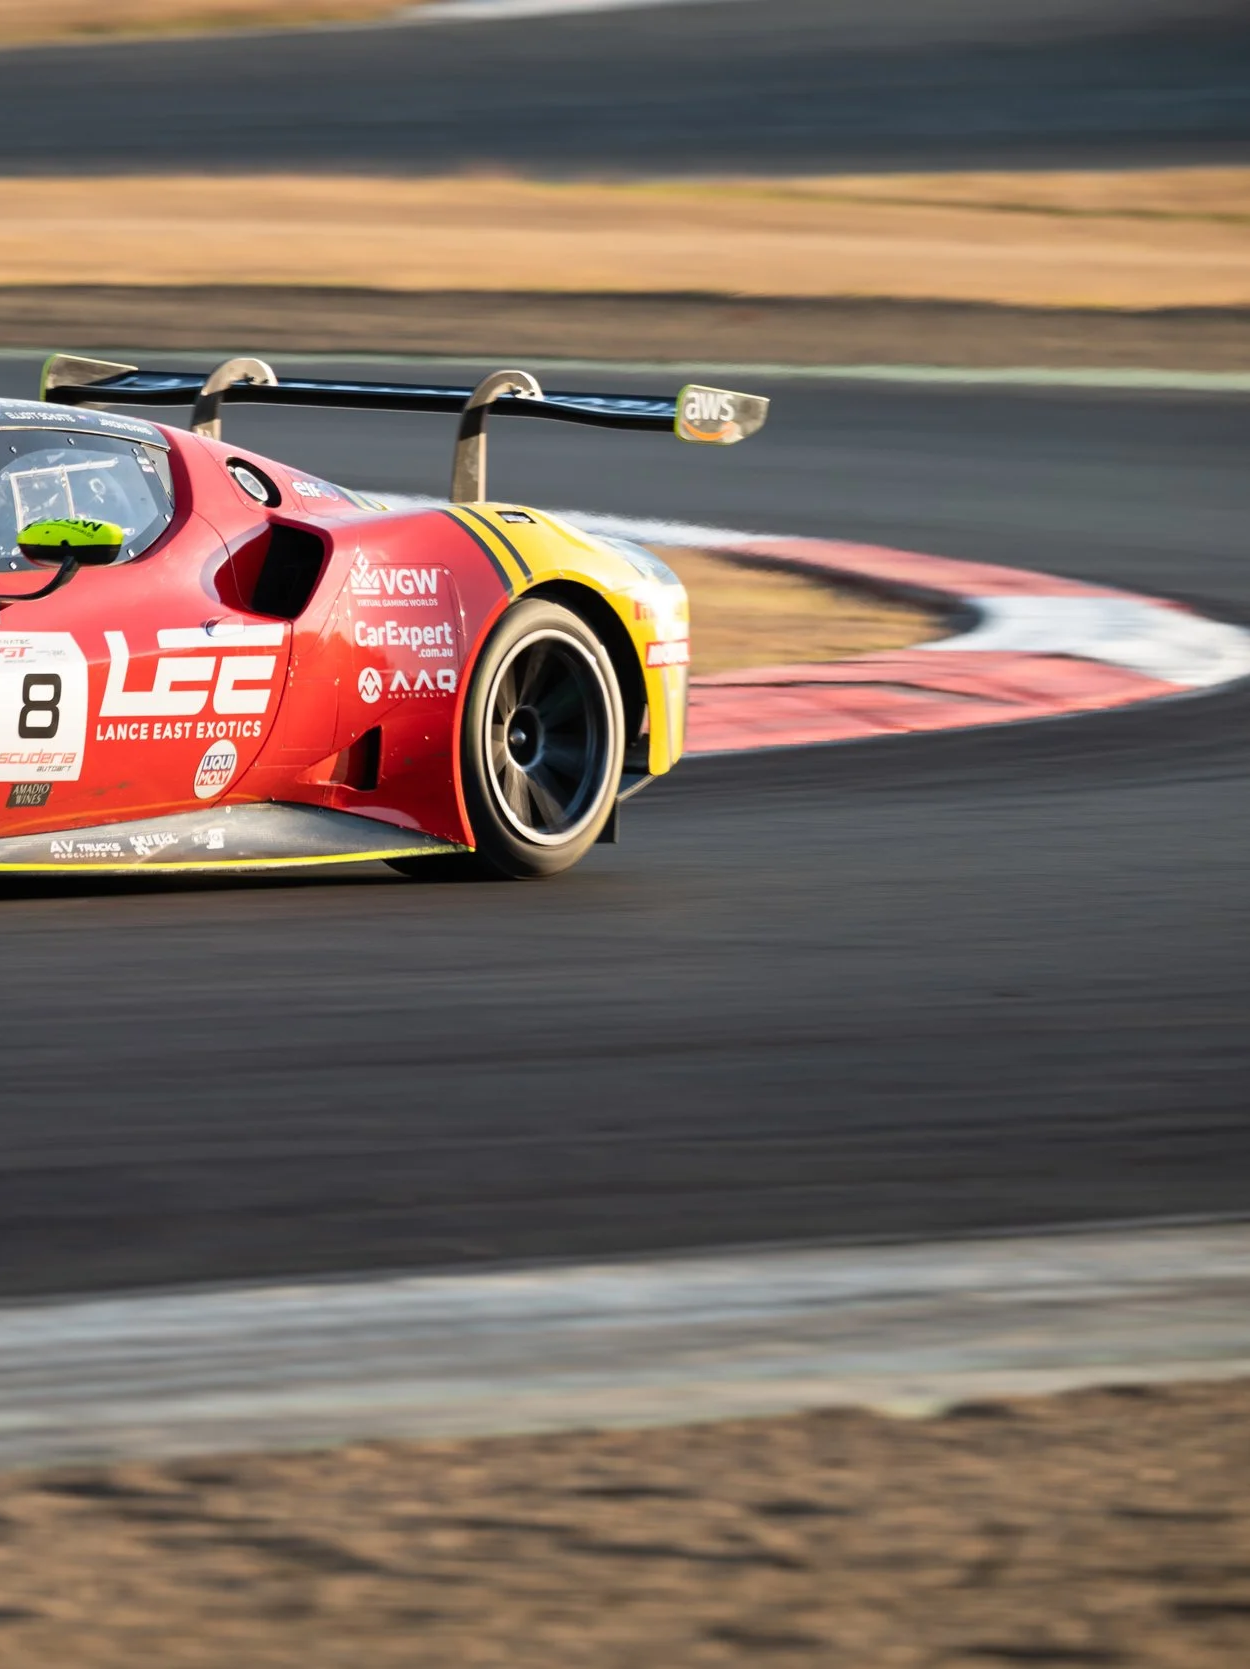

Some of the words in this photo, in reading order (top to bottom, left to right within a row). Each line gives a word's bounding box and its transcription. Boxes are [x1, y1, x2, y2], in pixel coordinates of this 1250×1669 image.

[685, 391, 735, 421] aws
[291, 481, 322, 498] elf
[379, 568, 437, 595] VGW
[357, 599, 381, 607] VIRTUAL
[382, 599, 409, 607] GAMING
[409, 599, 438, 607] WORLDS
[355, 621, 453, 650] CarExpert
[418, 648, 453, 657] .com.au
[99, 623, 285, 717] LEE
[18, 673, 62, 739] 8
[96, 722, 149, 741] LANCE
[153, 722, 192, 740] EAST
[196, 720, 262, 739] EXOTICS
[202, 754, 235, 771] LIQUI
[197, 770, 230, 786] MOLY
[13, 784, 50, 795] AMADIO
[15, 794, 42, 805] WINES
[50, 840, 74, 853] AV
[77, 842, 121, 852] TRUCKS
